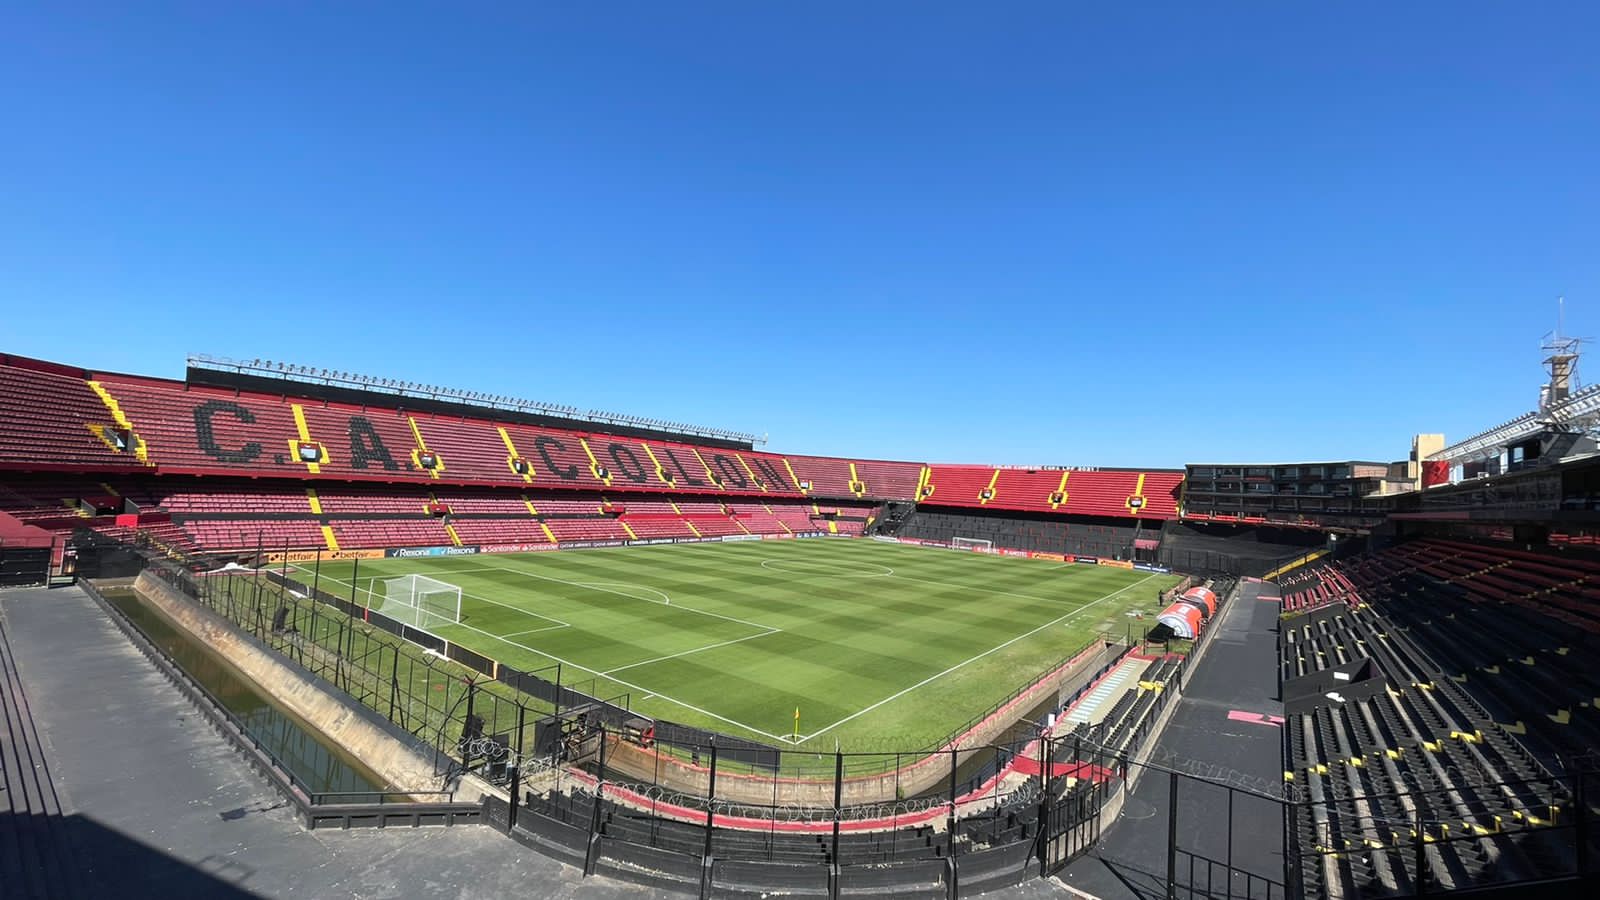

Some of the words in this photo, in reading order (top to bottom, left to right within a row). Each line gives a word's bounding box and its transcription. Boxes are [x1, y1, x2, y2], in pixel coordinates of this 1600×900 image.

[447, 546, 475, 555] Rexona
[487, 544, 521, 552] Santander
[528, 543, 558, 551] Santander
[400, 548, 430, 557] Rexona
